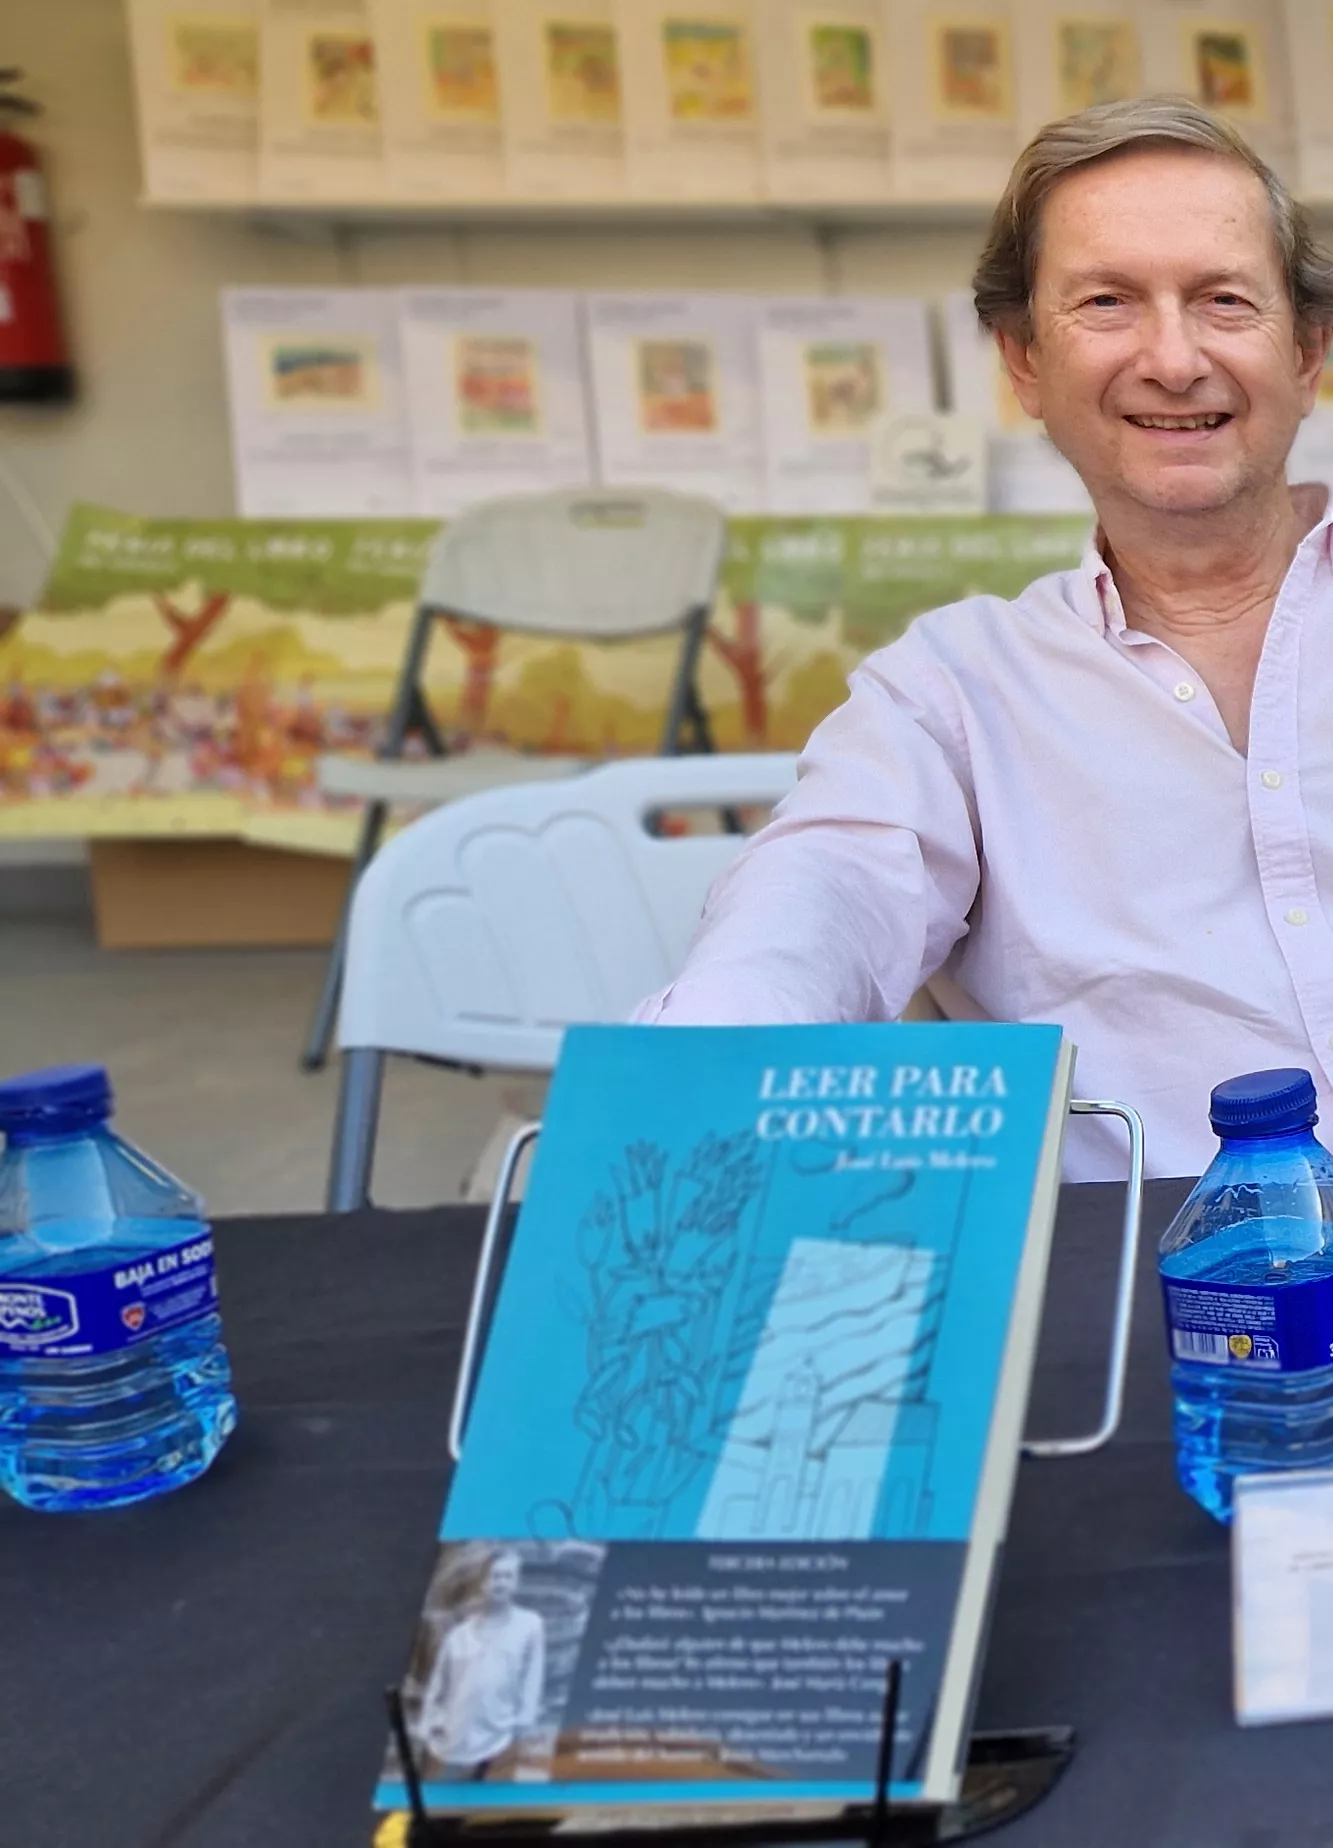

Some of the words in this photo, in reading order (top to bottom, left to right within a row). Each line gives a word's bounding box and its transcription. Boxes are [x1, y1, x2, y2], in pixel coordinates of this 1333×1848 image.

[758, 1066, 878, 1100] LEER
[890, 1065, 1008, 1098] PARA
[755, 1104, 1004, 1140] CONTARLO
[835, 1149, 875, 1170] José
[929, 1149, 997, 1169] Melero
[113, 1262, 155, 1290] BAJA
[157, 1253, 179, 1274] EN
